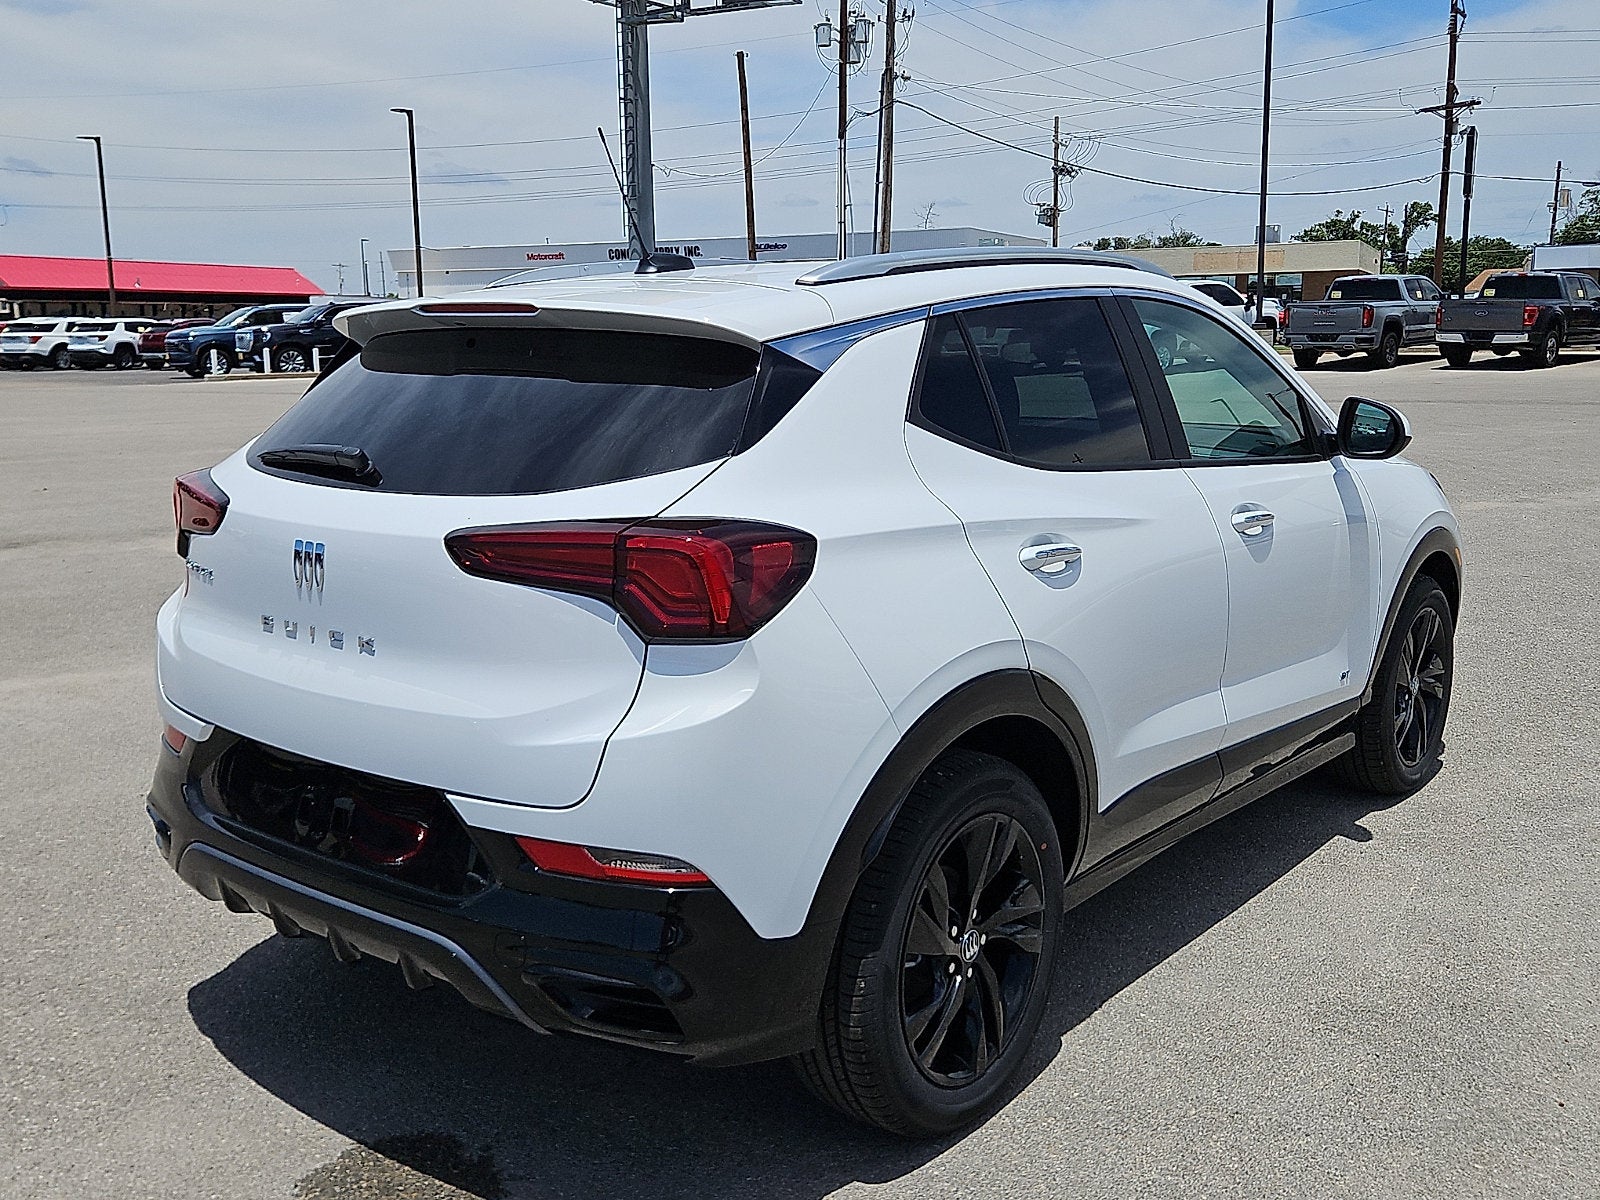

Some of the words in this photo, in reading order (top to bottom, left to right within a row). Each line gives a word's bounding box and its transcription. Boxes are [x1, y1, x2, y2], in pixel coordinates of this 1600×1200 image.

[526, 251, 566, 261] Motorcraft
[684, 245, 704, 257] INC.
[261, 614, 375, 656] BUICK
